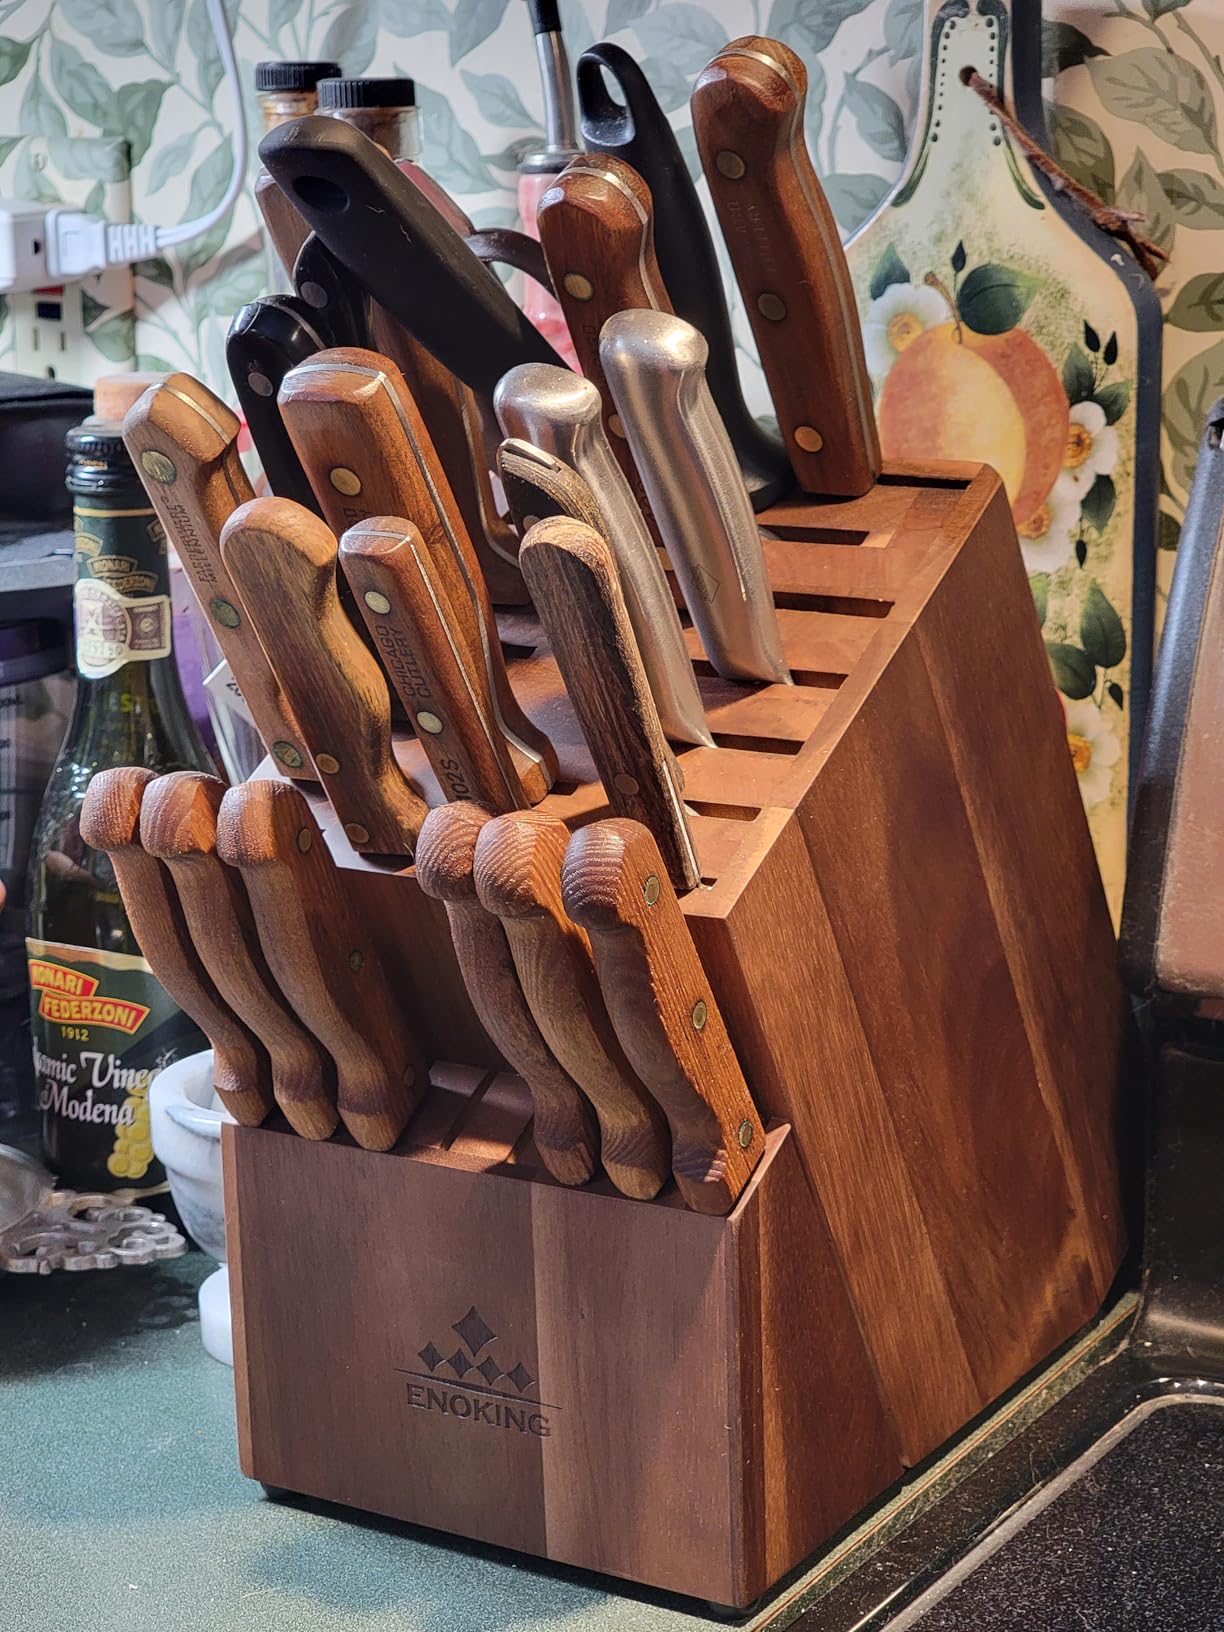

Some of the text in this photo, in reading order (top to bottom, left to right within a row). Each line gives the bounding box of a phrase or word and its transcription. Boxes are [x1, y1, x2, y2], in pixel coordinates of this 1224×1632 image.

[375, 624, 417, 697] CHICAGO
[388, 626, 431, 698] CUTLERY
[43, 999, 137, 1028] FEDERZONI
[61, 1026, 90, 1042] 1912
[40, 1079, 136, 1126] Modena
[406, 1382, 552, 1438] ENOKING
